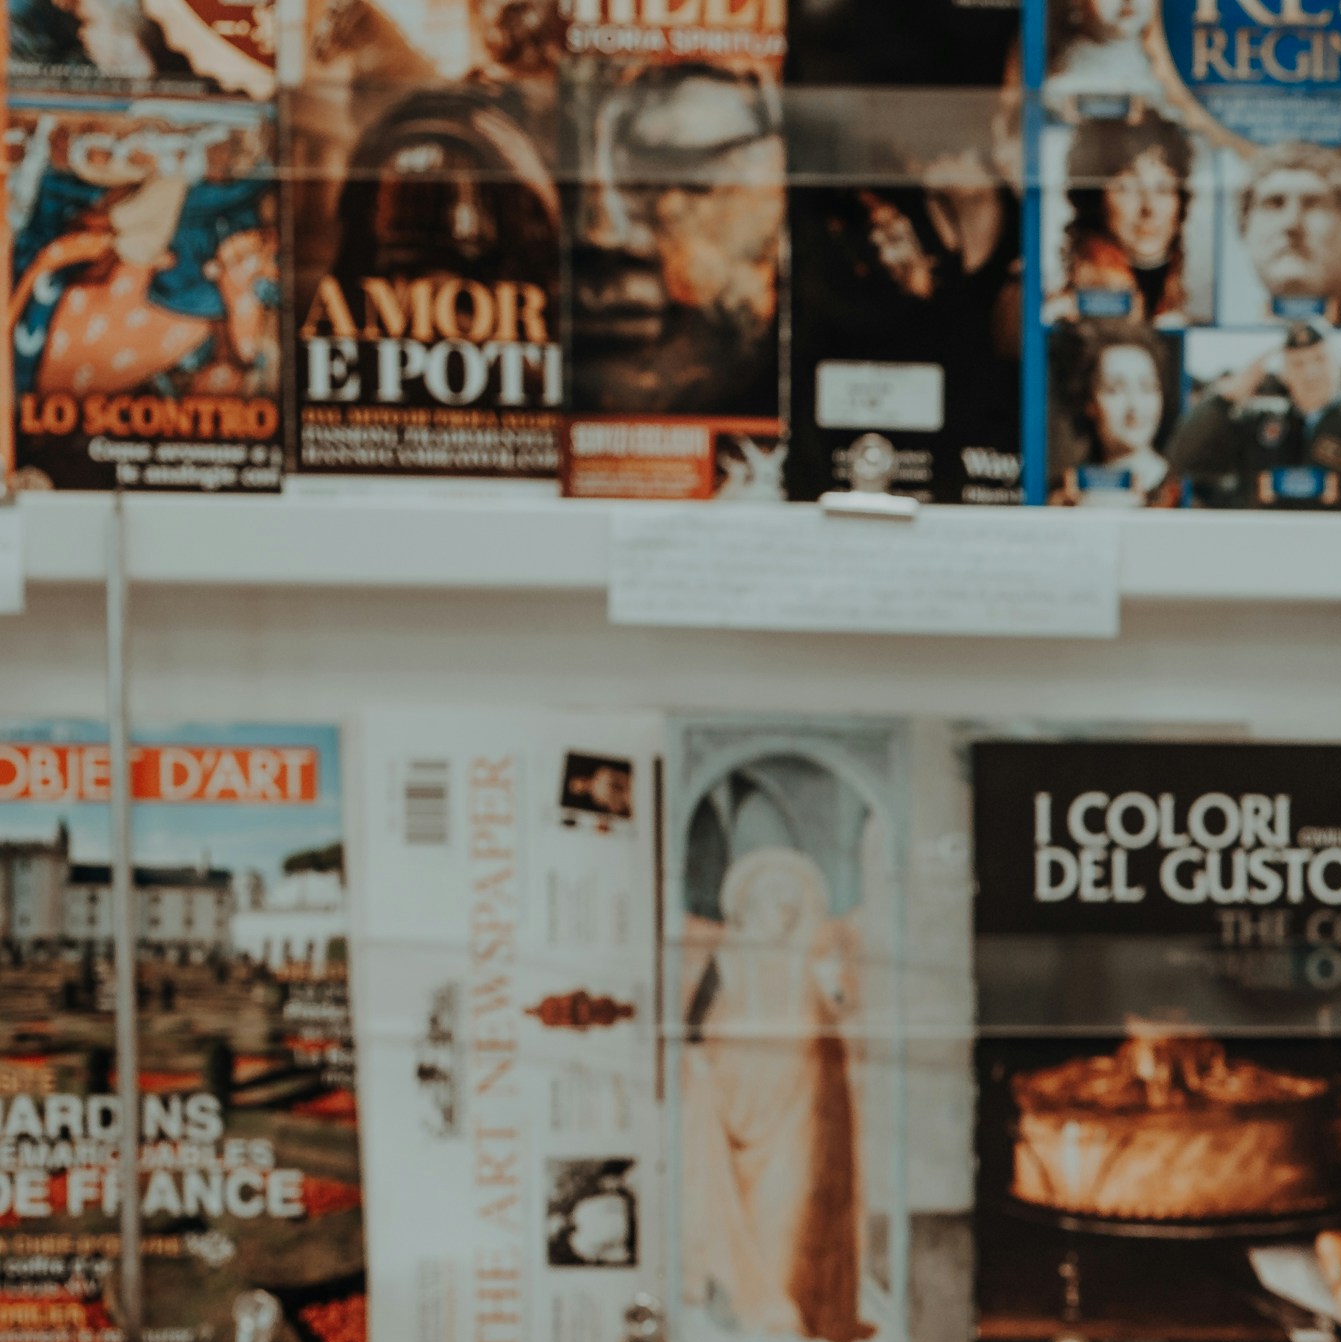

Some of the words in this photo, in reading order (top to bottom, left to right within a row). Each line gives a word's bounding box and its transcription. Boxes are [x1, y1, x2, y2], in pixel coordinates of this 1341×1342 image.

[303, 275, 548, 341] AMOR
[159, 747, 316, 803] D'ART
[1065, 790, 1292, 850] COLORI
[1034, 848, 1147, 904] DEL
